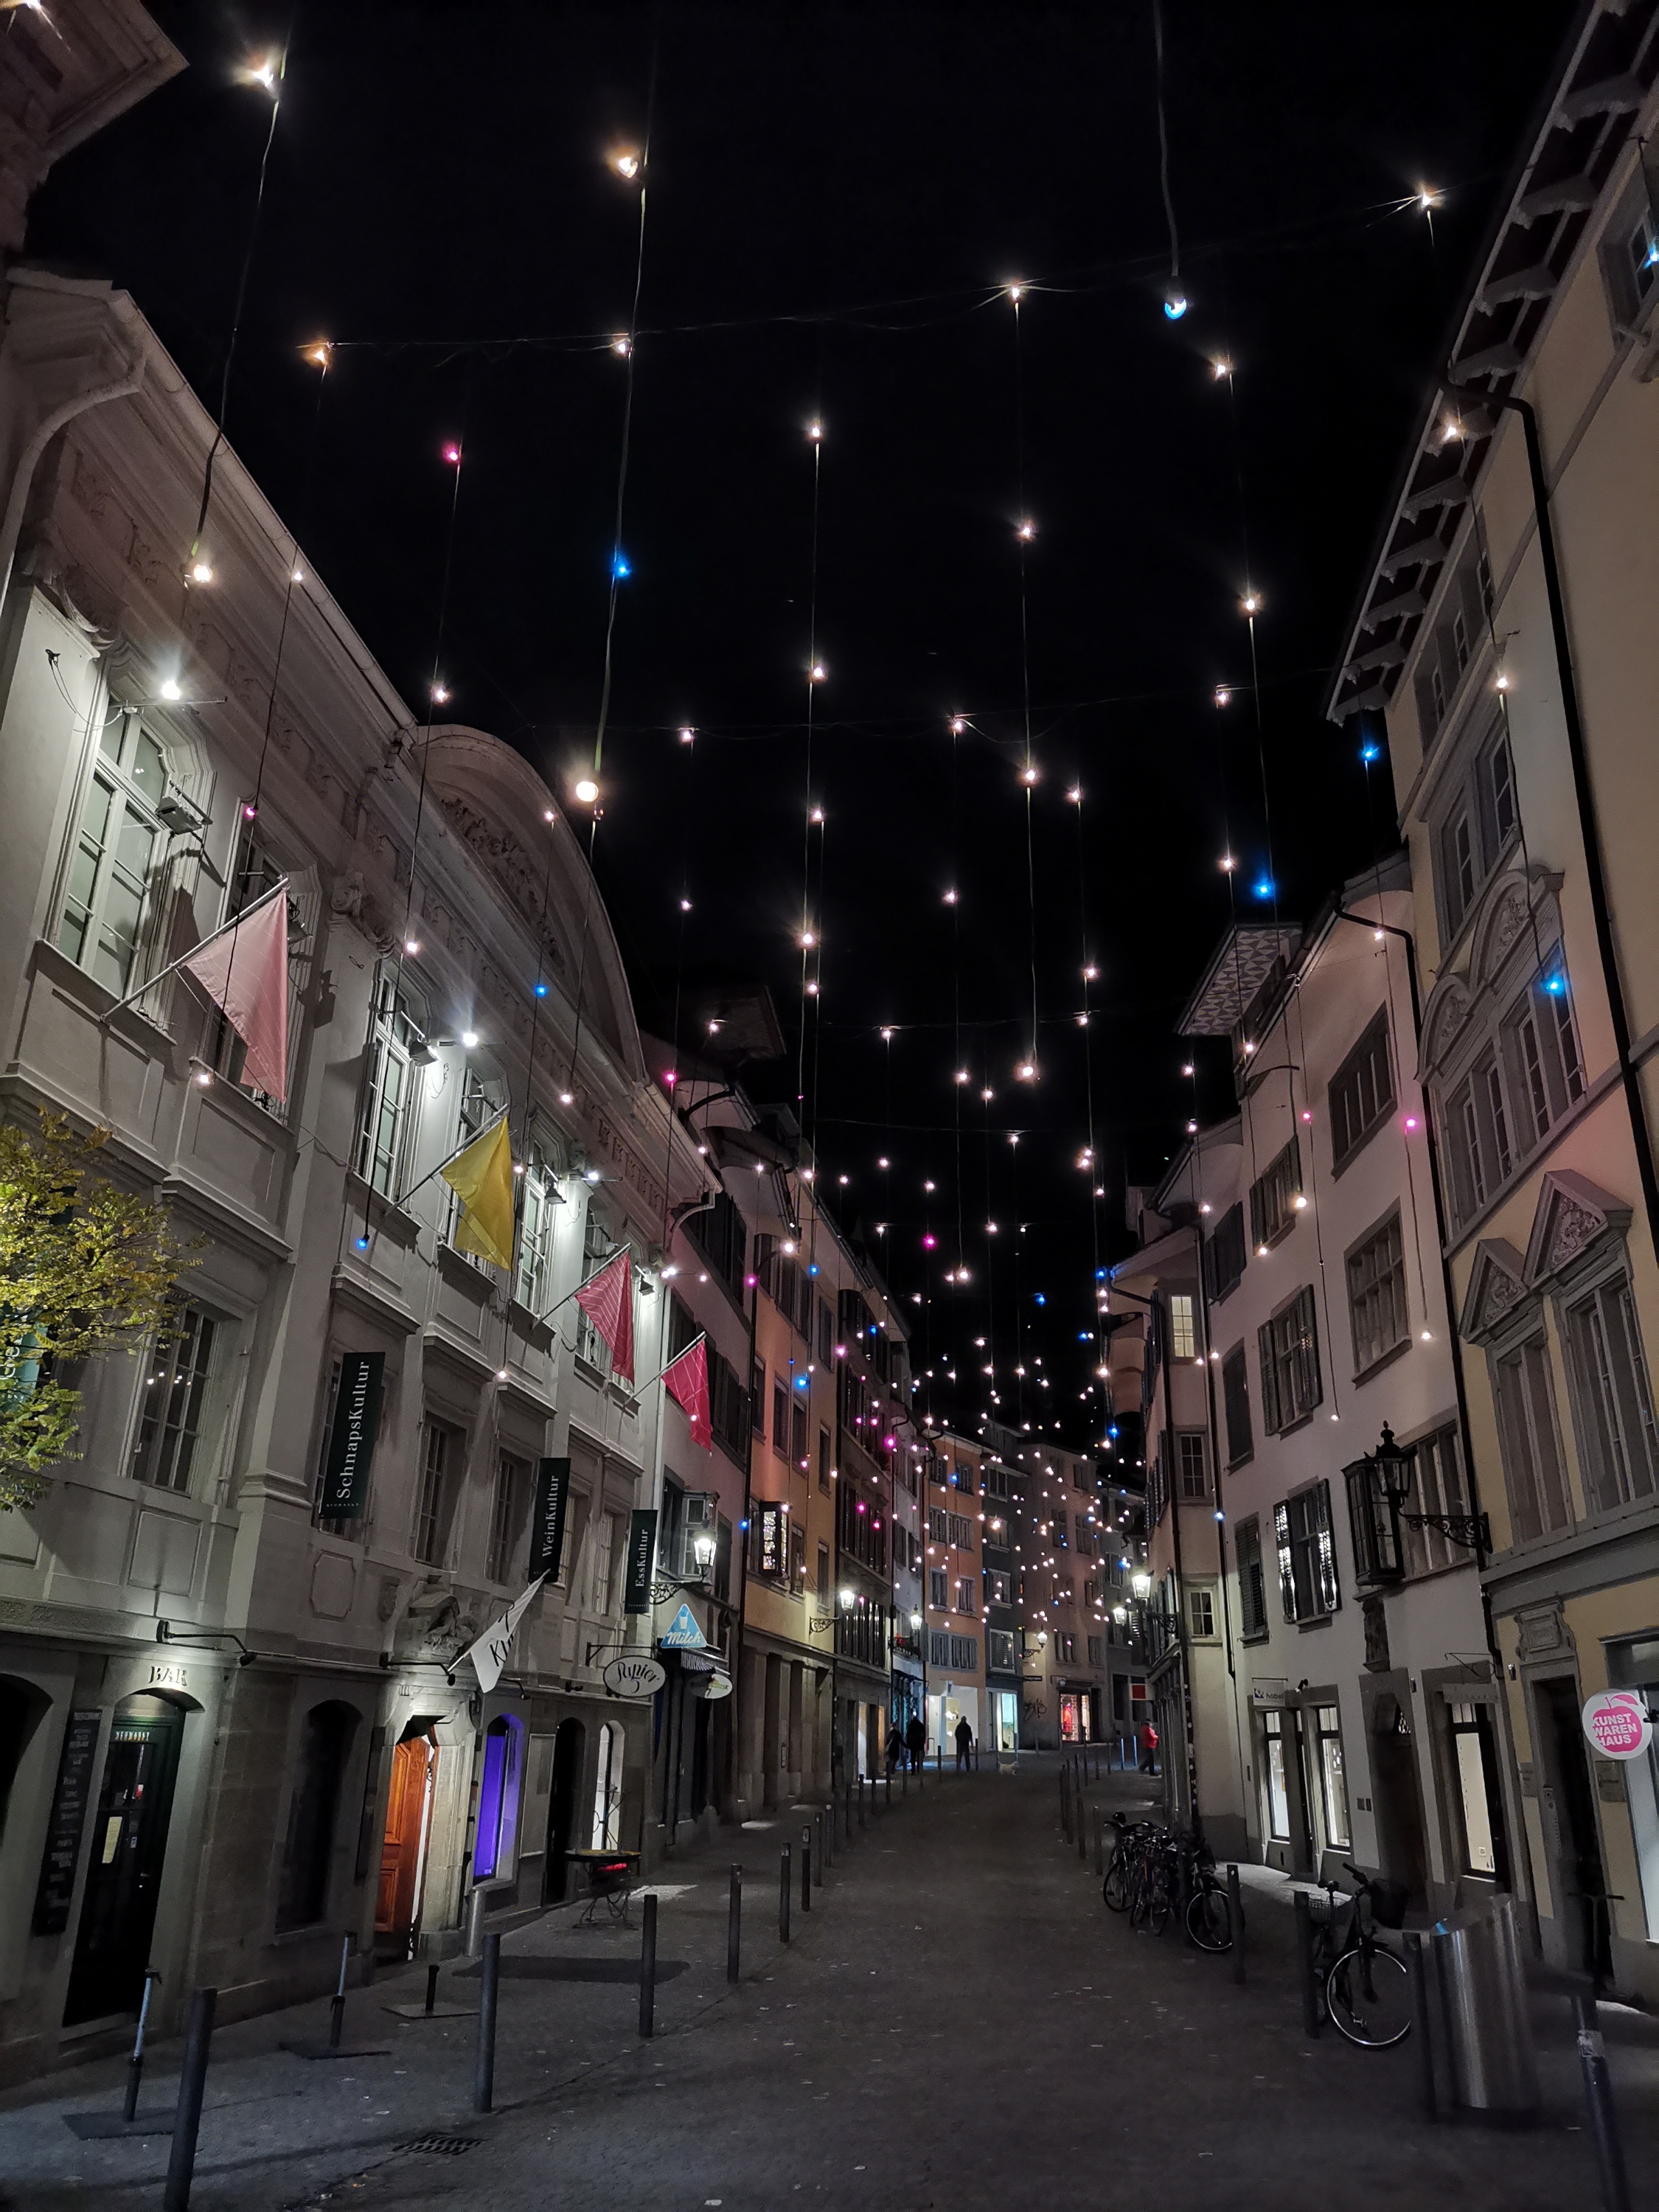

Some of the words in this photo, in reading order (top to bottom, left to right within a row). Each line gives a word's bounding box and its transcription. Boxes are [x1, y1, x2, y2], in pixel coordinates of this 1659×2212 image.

[335, 1360, 370, 1498] SchnapsKultur
[542, 1475, 559, 1557] WeinKultur
[635, 1528, 649, 1587] EssKultur
[667, 1631, 701, 1646] Milch
[147, 1666, 188, 1686] BAR
[1591, 1712, 1632, 1727] KUNST
[1593, 1723, 1638, 1736] WAREN
[1596, 1734, 1632, 1747] HAUS
